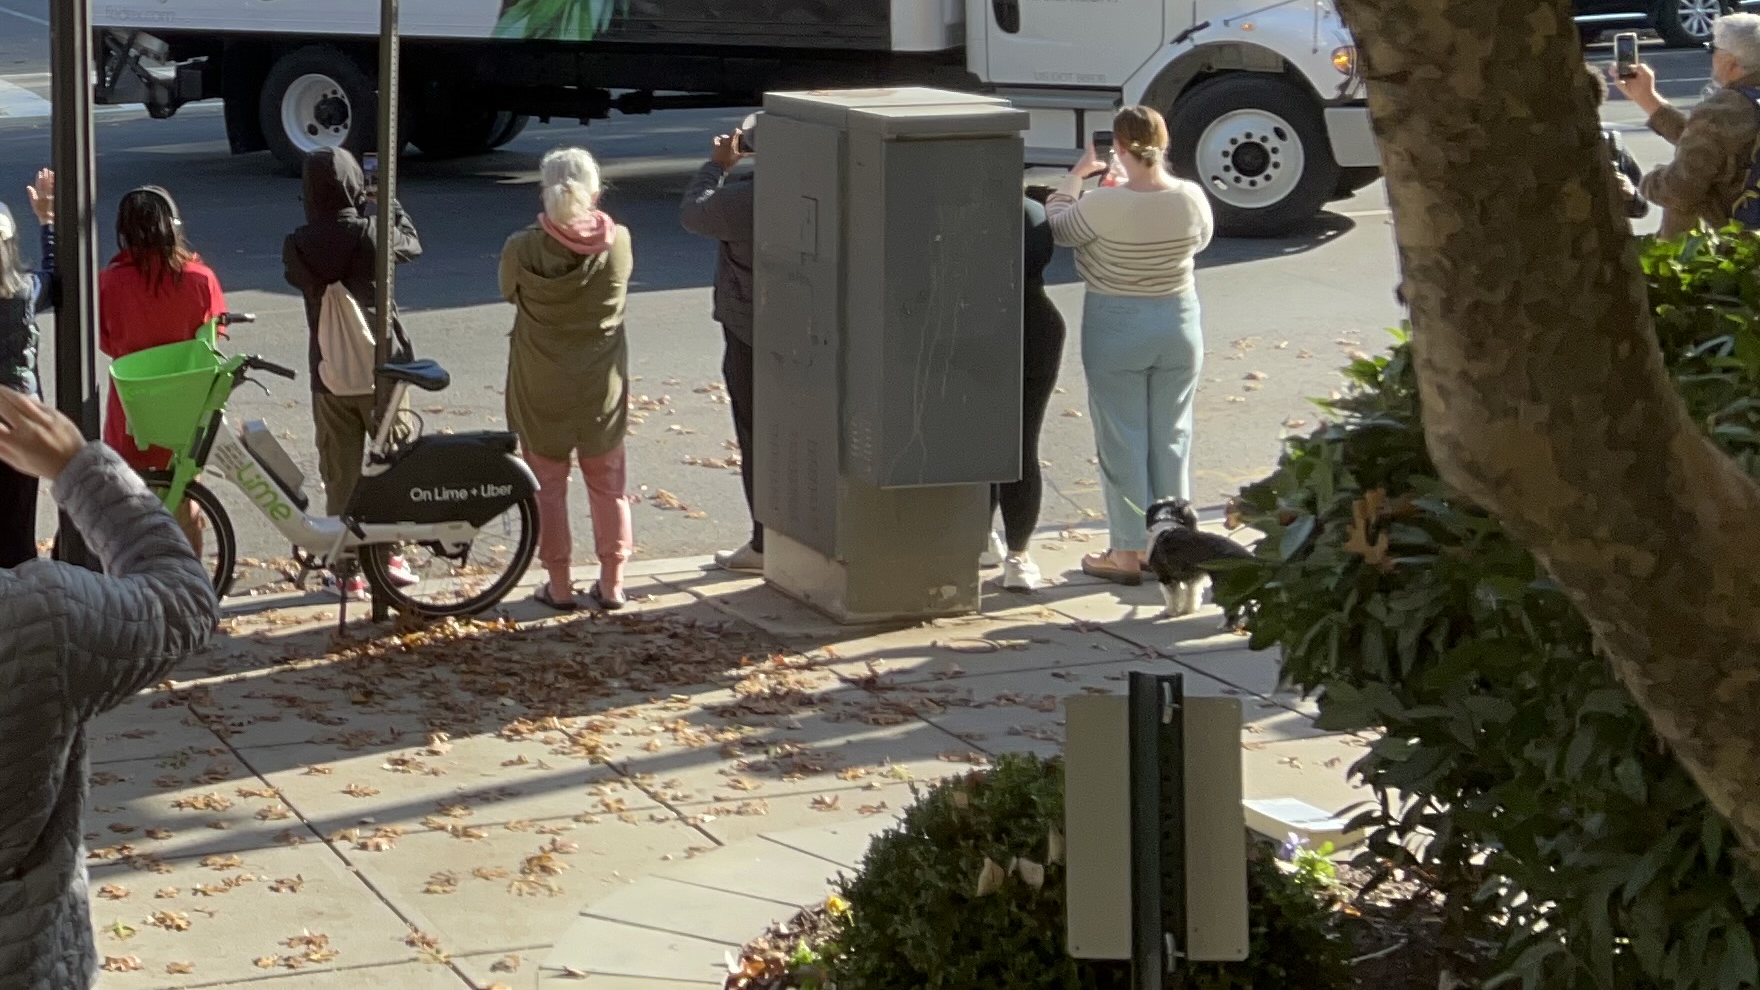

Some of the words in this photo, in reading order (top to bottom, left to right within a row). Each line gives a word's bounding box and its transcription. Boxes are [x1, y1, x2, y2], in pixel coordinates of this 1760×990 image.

[236, 461, 292, 521] Lime
[409, 487, 433, 502] On
[434, 486, 469, 501] Lime
[480, 484, 513, 498] Uber
